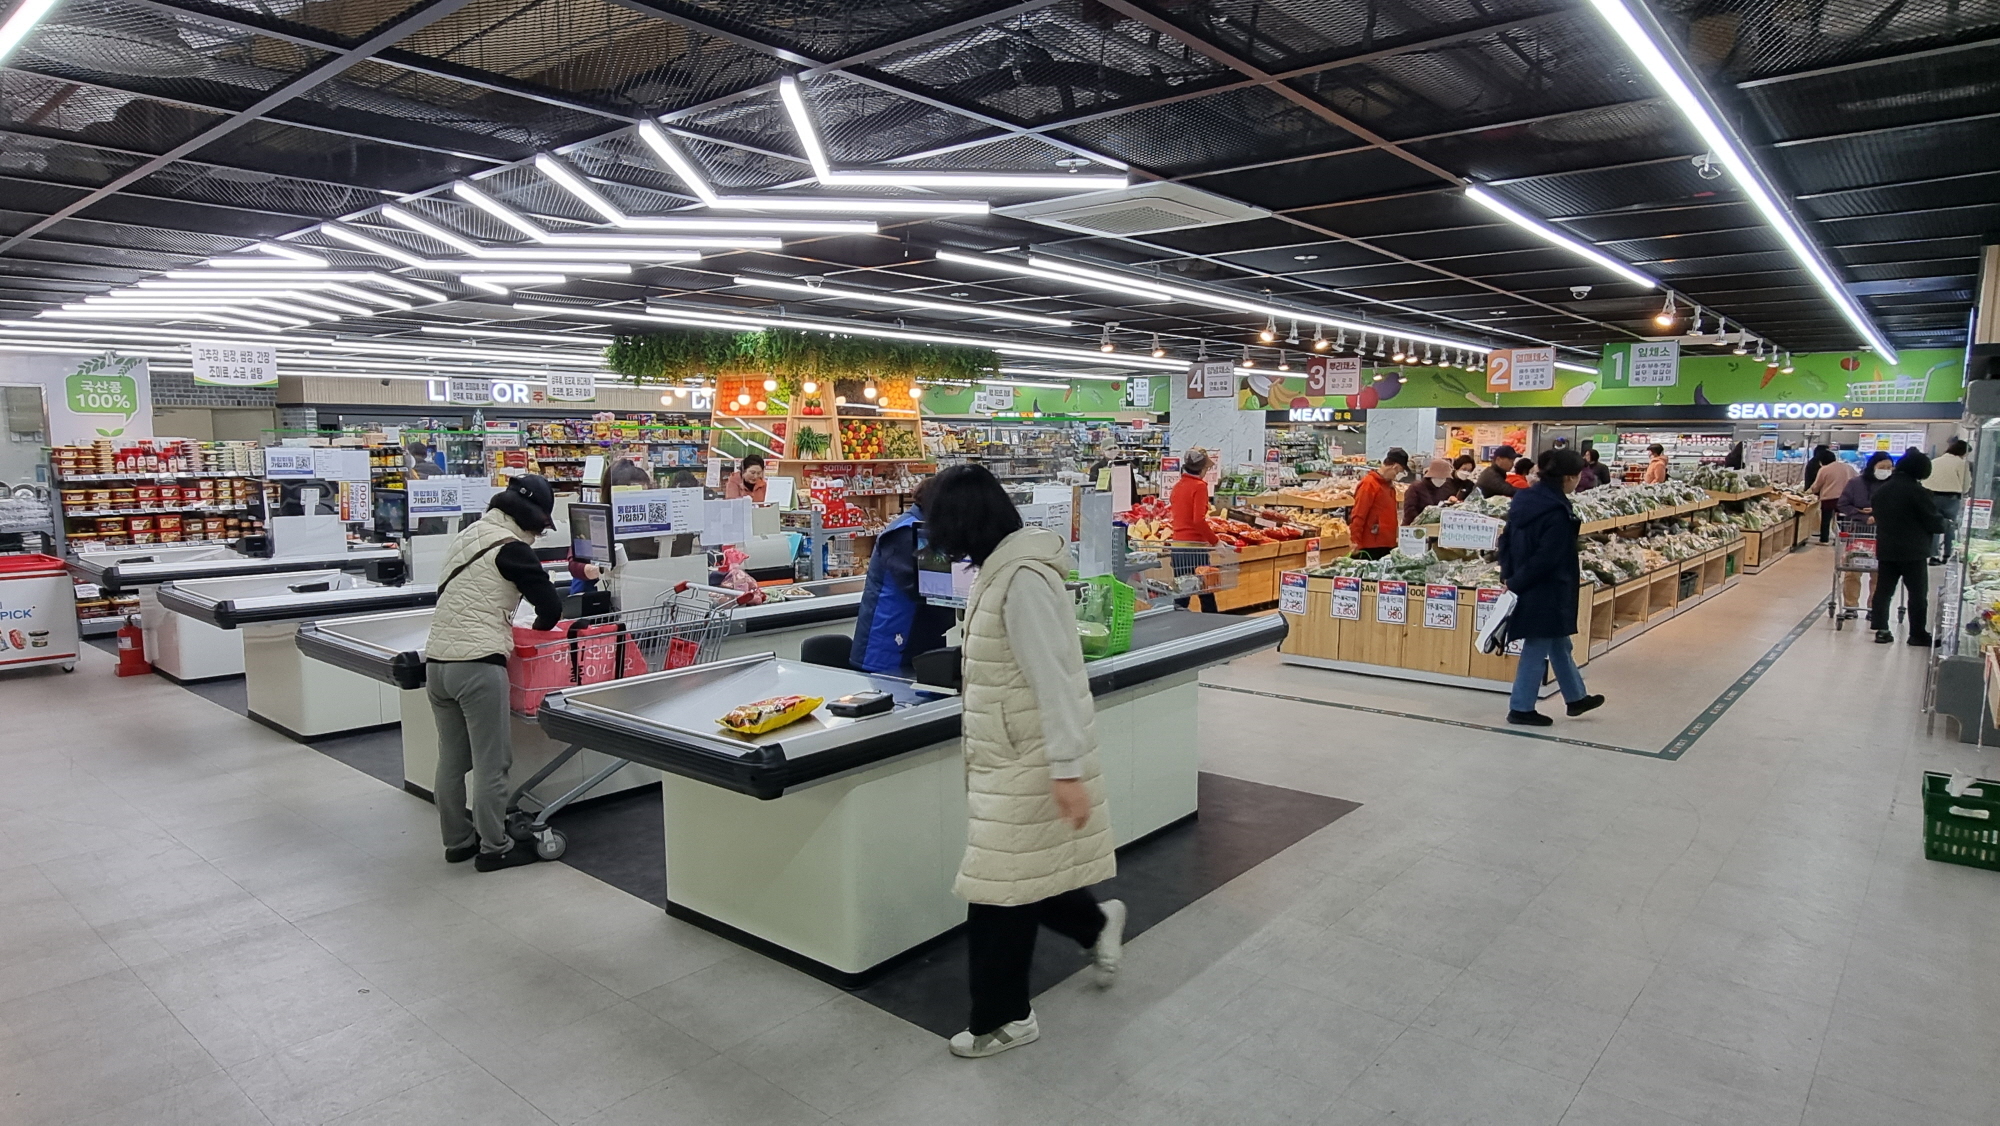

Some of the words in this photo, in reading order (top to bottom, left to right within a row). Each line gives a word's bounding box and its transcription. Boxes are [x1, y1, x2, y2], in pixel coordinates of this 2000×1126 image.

[199, 349, 221, 362] 고추장,
[223, 350, 238, 363] 된장,
[240, 350, 255, 364] 쌈장,
[257, 351, 270, 364] 간장
[1638, 347, 1670, 358] 잎채소
[209, 366, 231, 379] 조미료,
[233, 366, 248, 380] 소금,
[250, 367, 263, 379] 설탕
[1490, 357, 1509, 385] 2
[1612, 352, 1623, 380] 1
[1189, 370, 1203, 392] 4
[1309, 365, 1325, 390] 3
[80, 380, 122, 393] 국산콩
[427, 380, 530, 404] LIOR
[1126, 382, 1134, 401] 5
[76, 394, 130, 408] 100%
[1289, 408, 1334, 422] MEAT
[1728, 403, 1769, 419] SEA
[1773, 403, 1836, 419] FOOD
[617, 504, 645, 513] 통합회원
[618, 513, 646, 522] 가입하기
